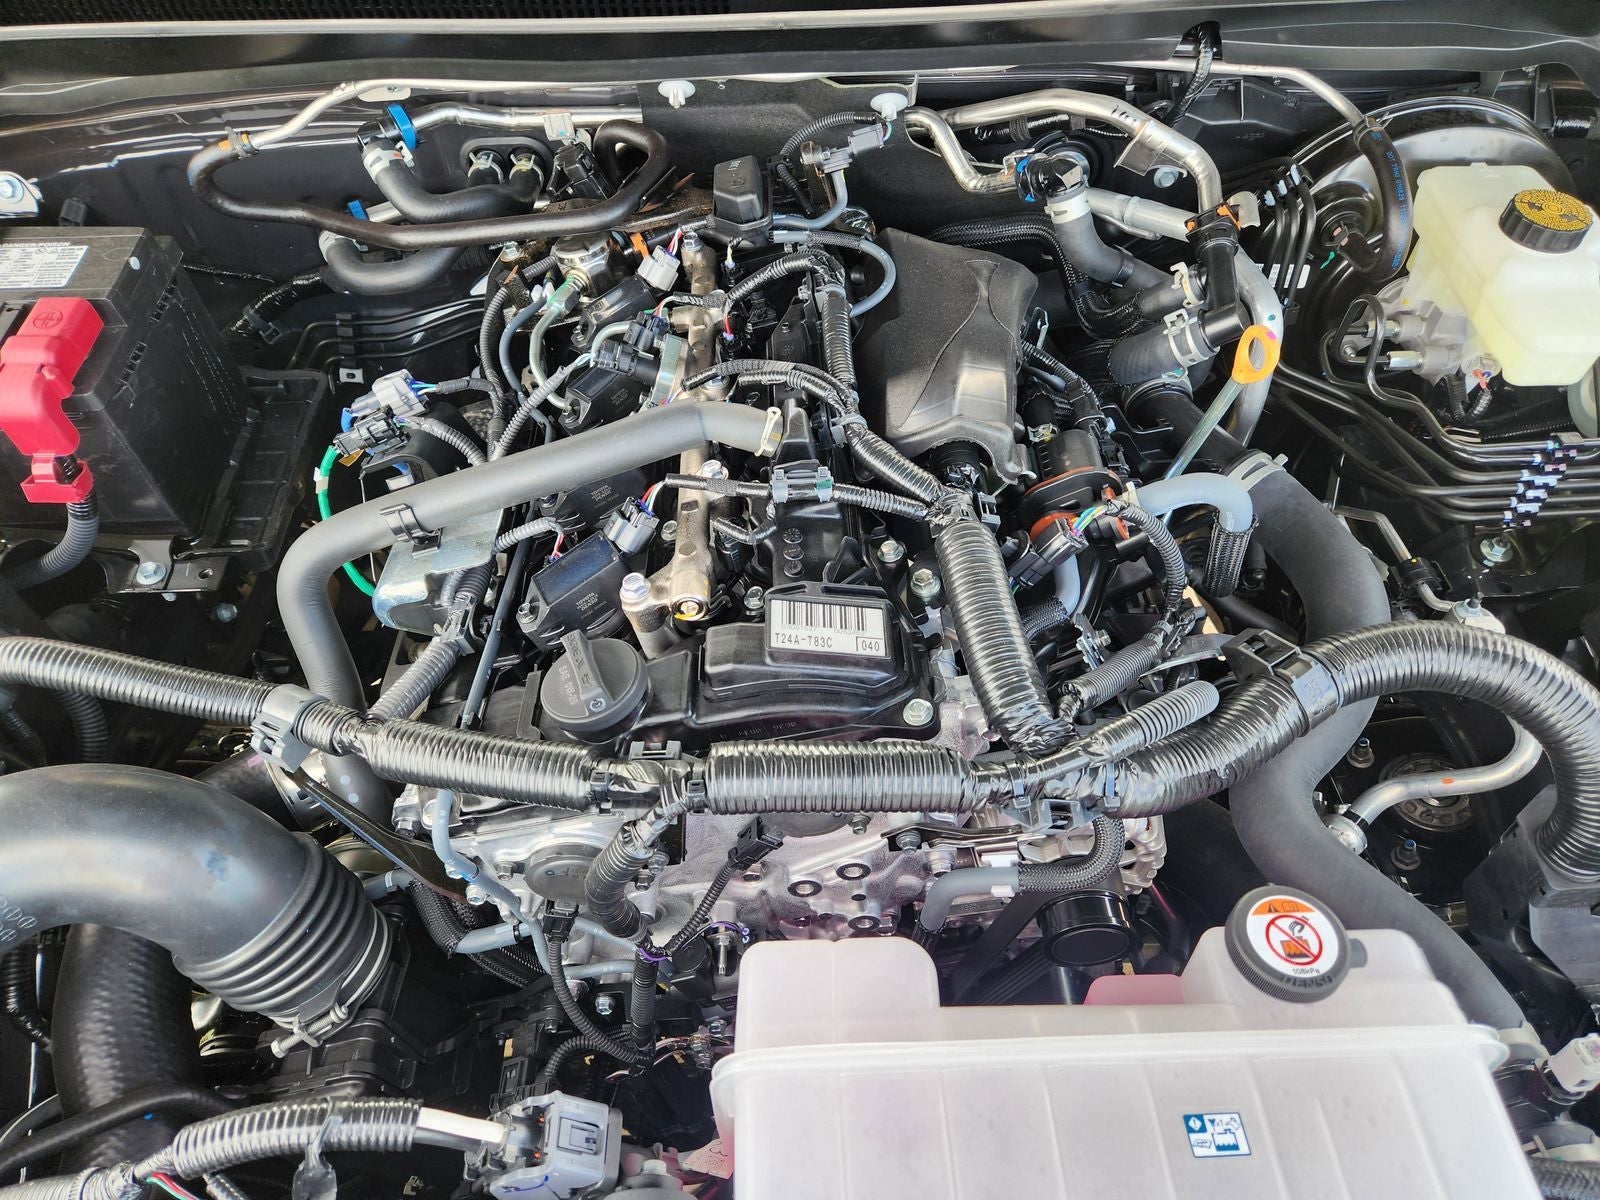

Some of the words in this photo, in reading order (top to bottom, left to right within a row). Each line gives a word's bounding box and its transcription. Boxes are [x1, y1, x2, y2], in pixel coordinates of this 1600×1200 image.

[774, 632, 833, 649] T24A-T83C
[861, 640, 880, 652] 040
[1281, 974, 1334, 989] DENSO
